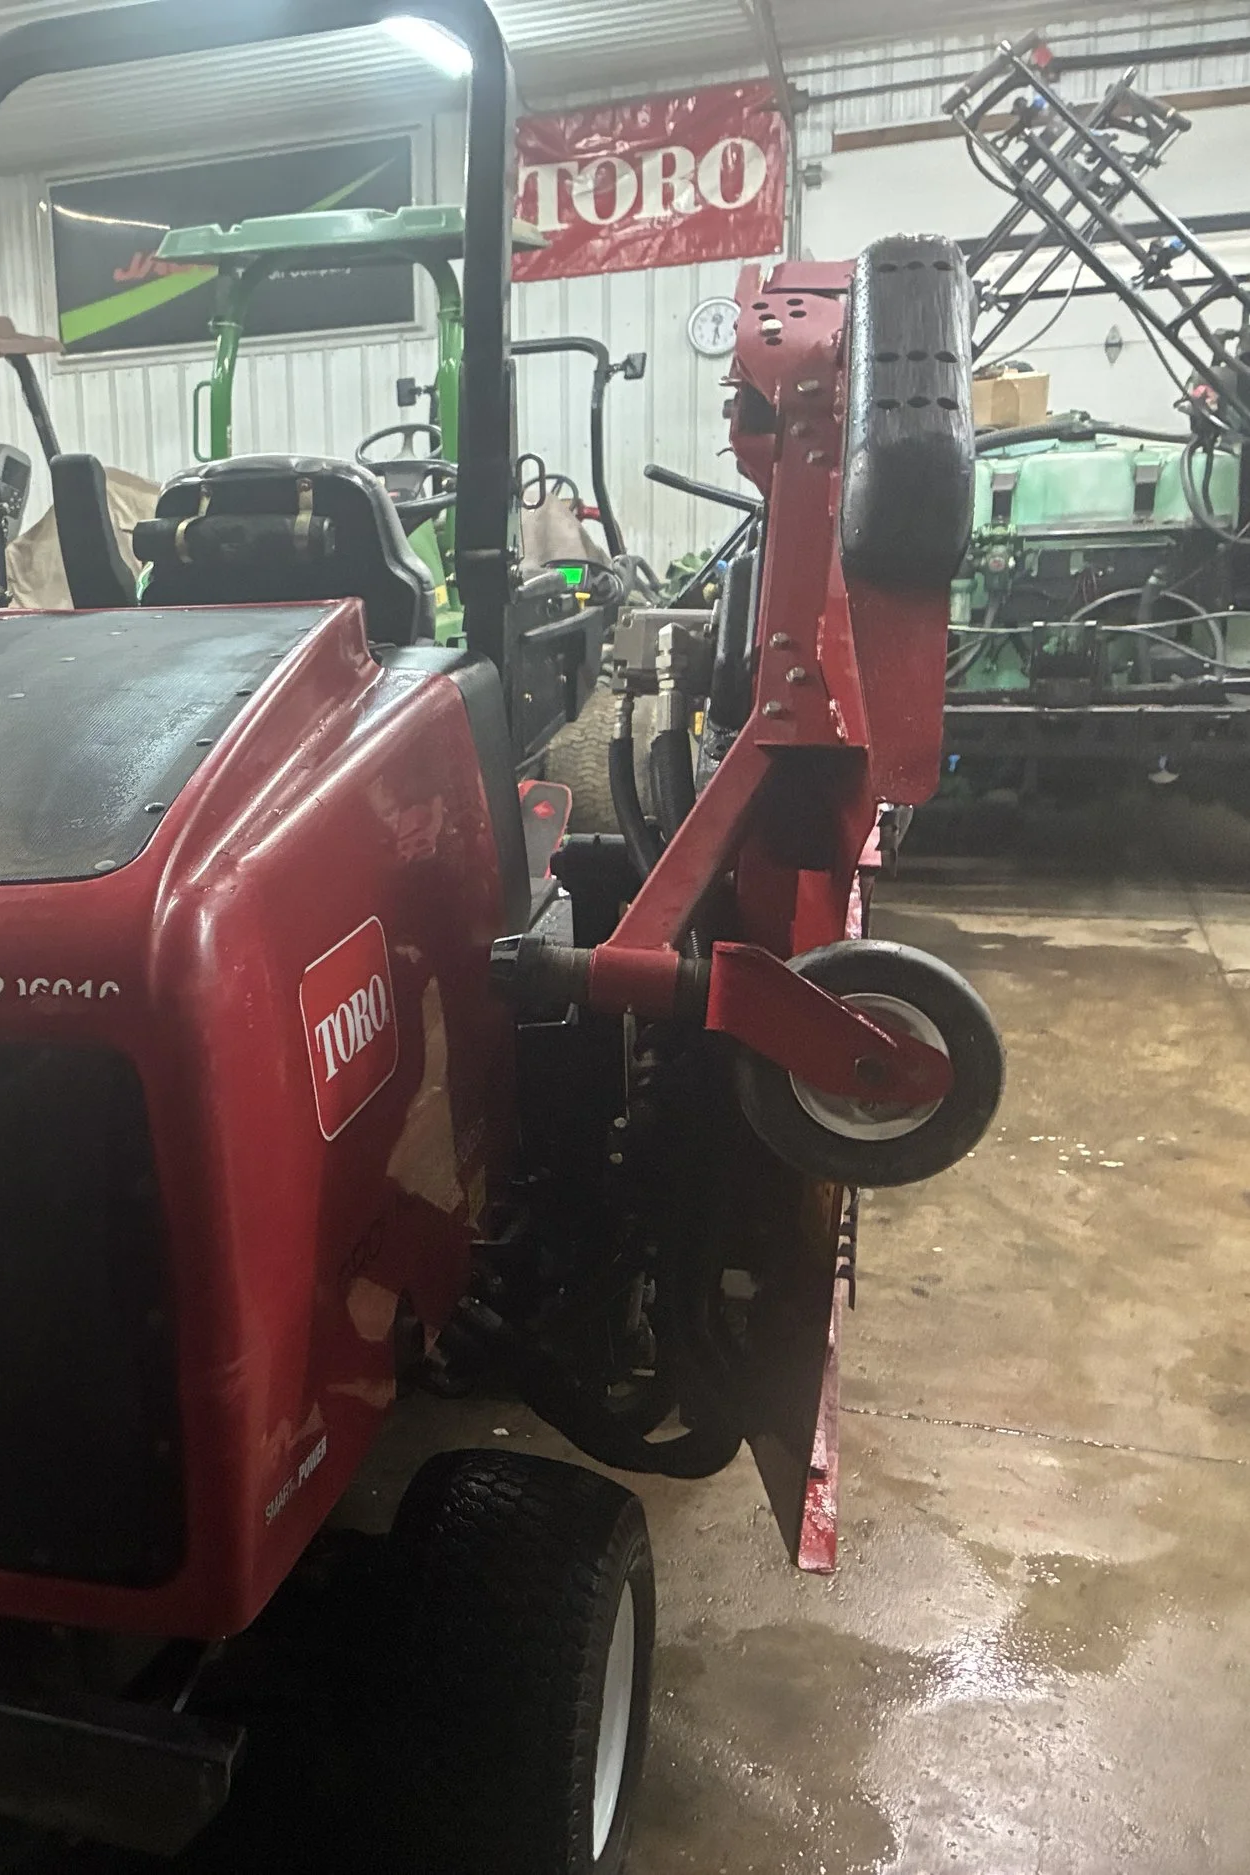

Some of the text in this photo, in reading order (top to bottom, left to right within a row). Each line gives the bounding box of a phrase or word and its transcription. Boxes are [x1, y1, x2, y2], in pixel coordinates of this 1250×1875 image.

[518, 137, 767, 232] TORO
[315, 974, 387, 1082] TORO
[298, 1434, 327, 1487] POWER
